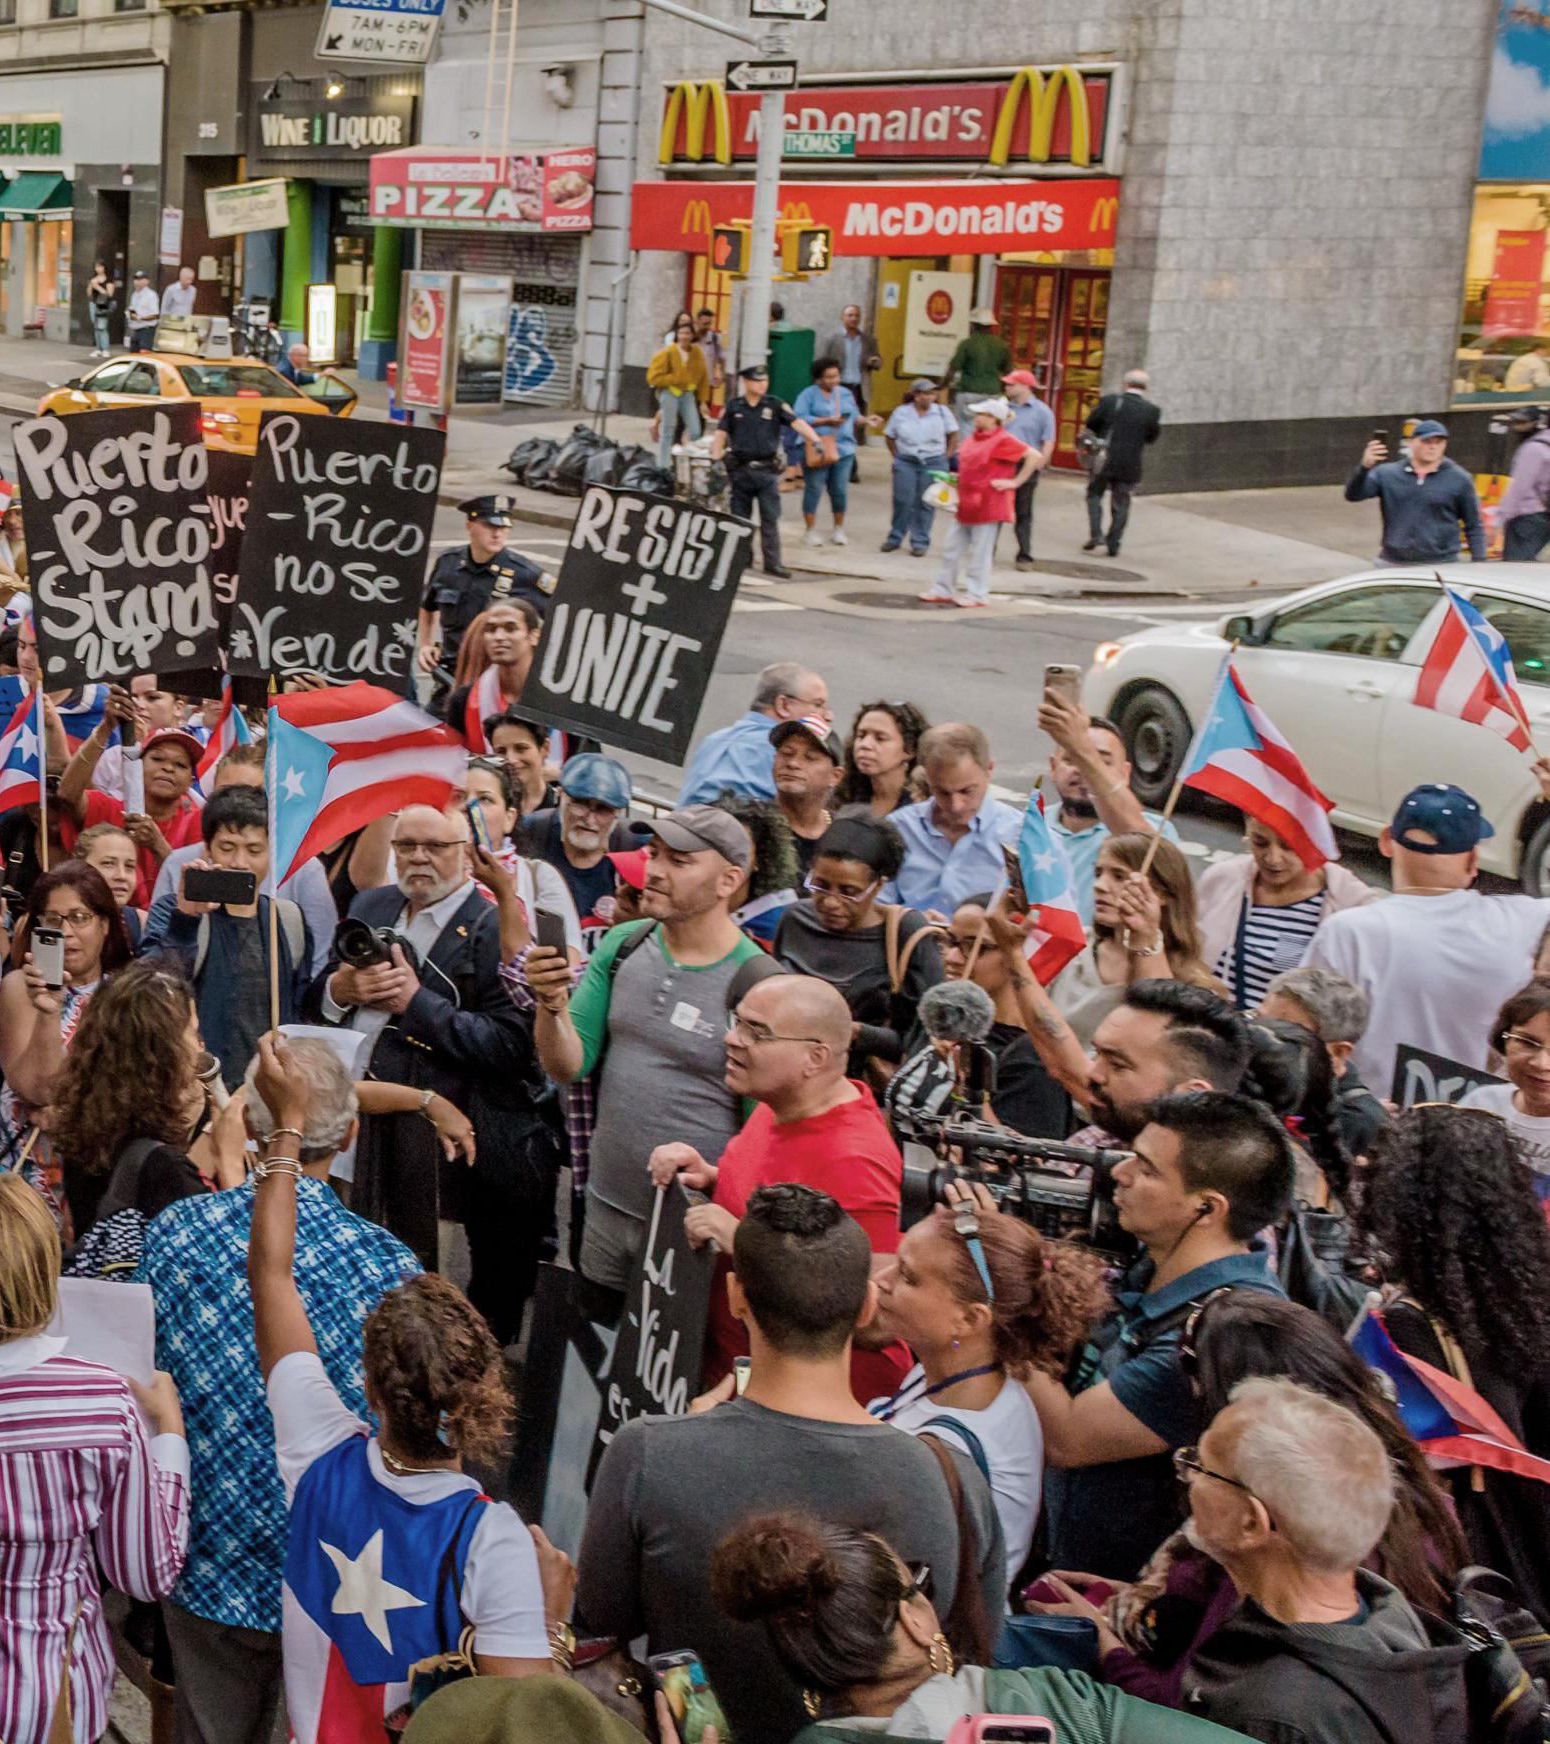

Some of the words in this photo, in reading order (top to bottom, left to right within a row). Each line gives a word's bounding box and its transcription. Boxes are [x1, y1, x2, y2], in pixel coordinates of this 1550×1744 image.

[736, 70, 759, 82] ONE
[199, 122, 218, 138] 315
[785, 132, 841, 153] THOMAS
[374, 186, 522, 219] PIZZA
[843, 201, 1064, 237] McDonald's
[545, 215, 593, 228] PIZZA
[13, 411, 209, 500] Puerto
[260, 415, 438, 494] Puerto
[571, 487, 752, 591] RESIST
[38, 564, 220, 643] Stand
[539, 603, 702, 734] UNITE
